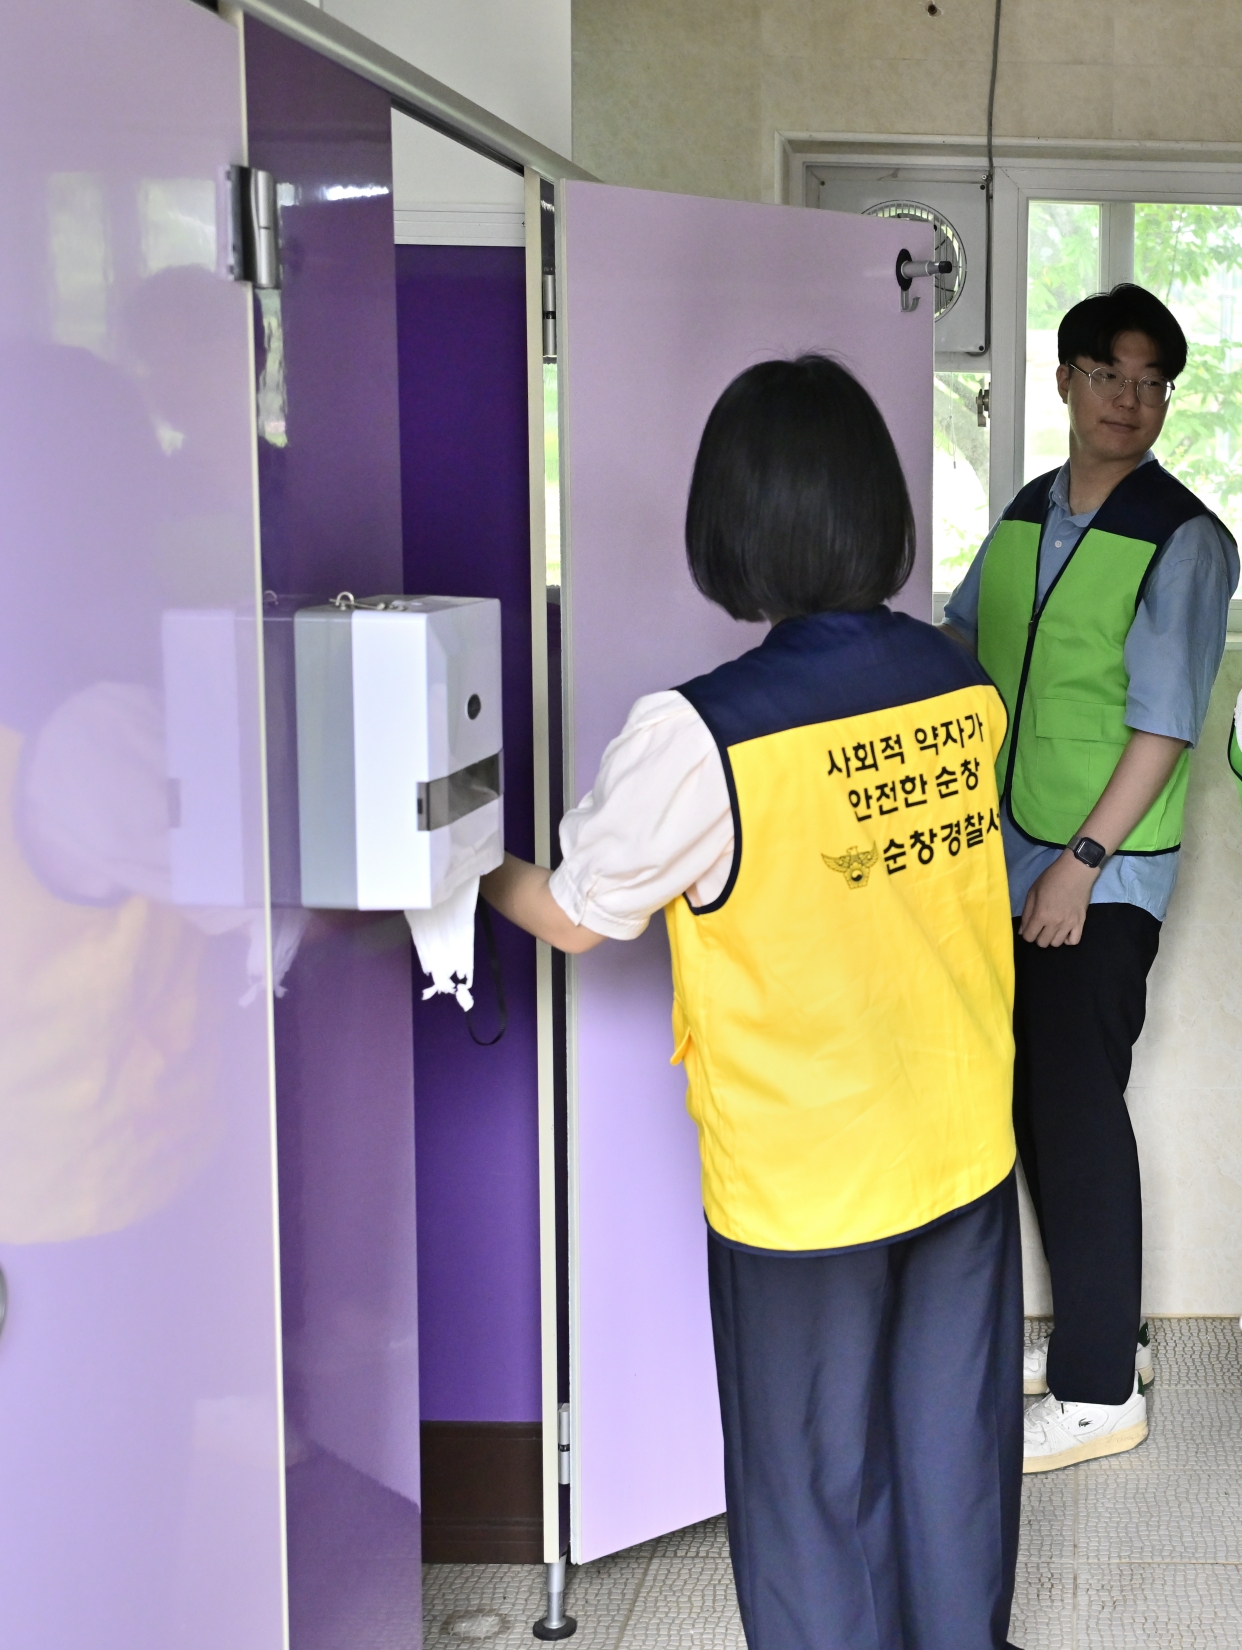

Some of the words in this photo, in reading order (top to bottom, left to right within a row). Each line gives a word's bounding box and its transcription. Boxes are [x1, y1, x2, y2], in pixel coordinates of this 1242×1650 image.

[827, 733, 905, 779] 사회적
[914, 712, 984, 756] 약자가
[848, 773, 928, 823] 안전한
[935, 757, 980, 799] 순창
